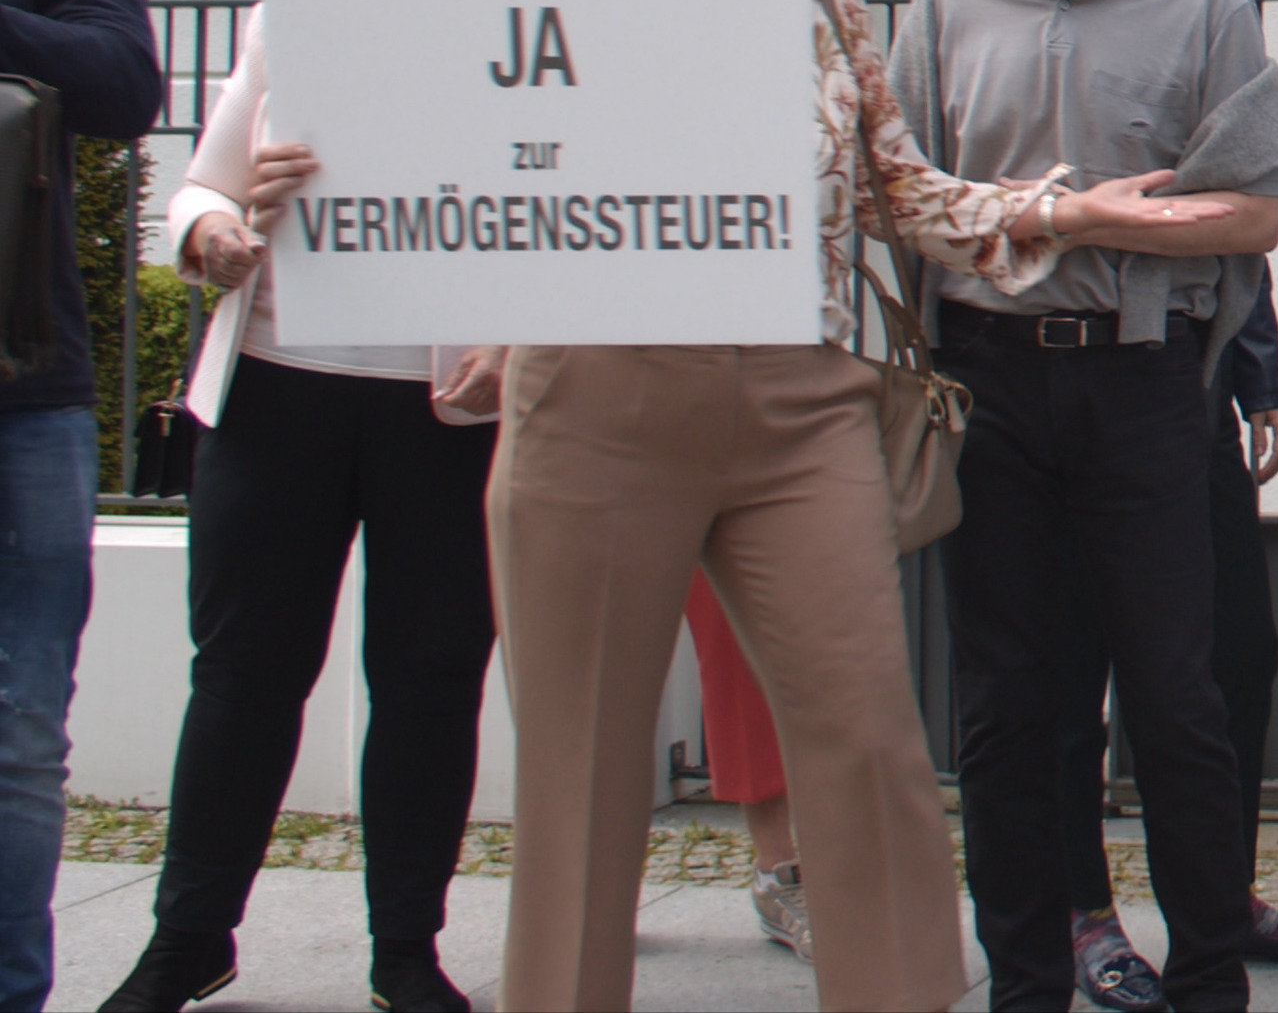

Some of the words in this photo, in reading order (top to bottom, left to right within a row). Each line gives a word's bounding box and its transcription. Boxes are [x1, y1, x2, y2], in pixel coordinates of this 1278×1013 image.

[489, 6, 577, 88] JA
[511, 141, 563, 171] zur
[298, 183, 792, 253] VERMÖGENSSTEUER!
